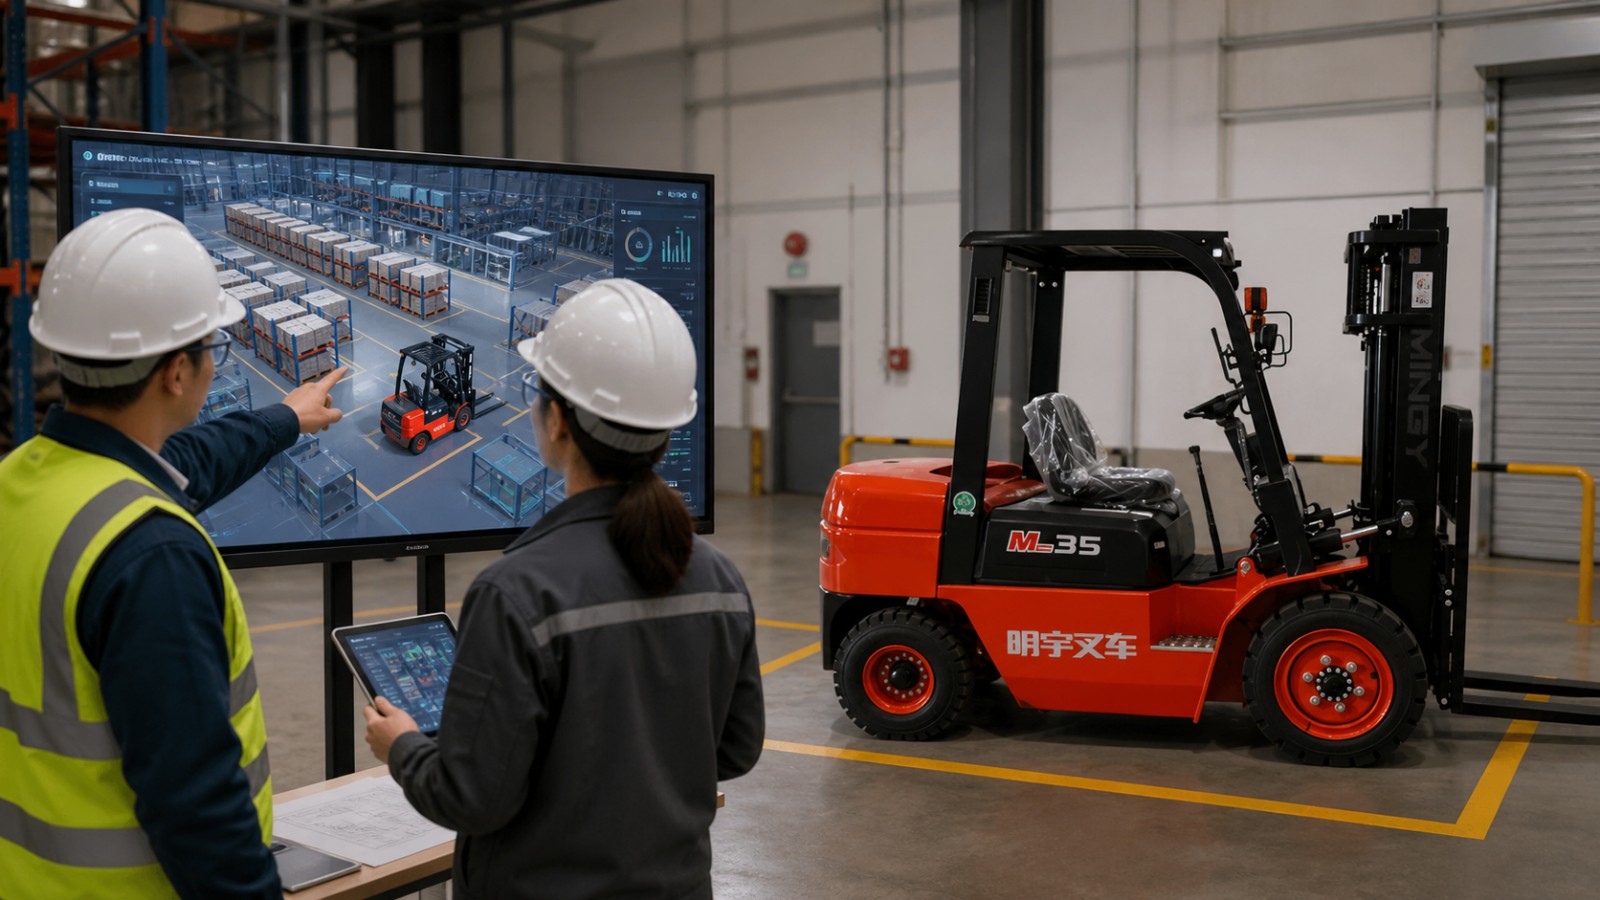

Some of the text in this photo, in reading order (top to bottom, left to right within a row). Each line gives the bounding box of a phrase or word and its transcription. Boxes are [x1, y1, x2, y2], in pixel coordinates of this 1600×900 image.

[1406, 329, 1434, 468] MINGY
[1007, 630, 1137, 660] 明宇叉车
